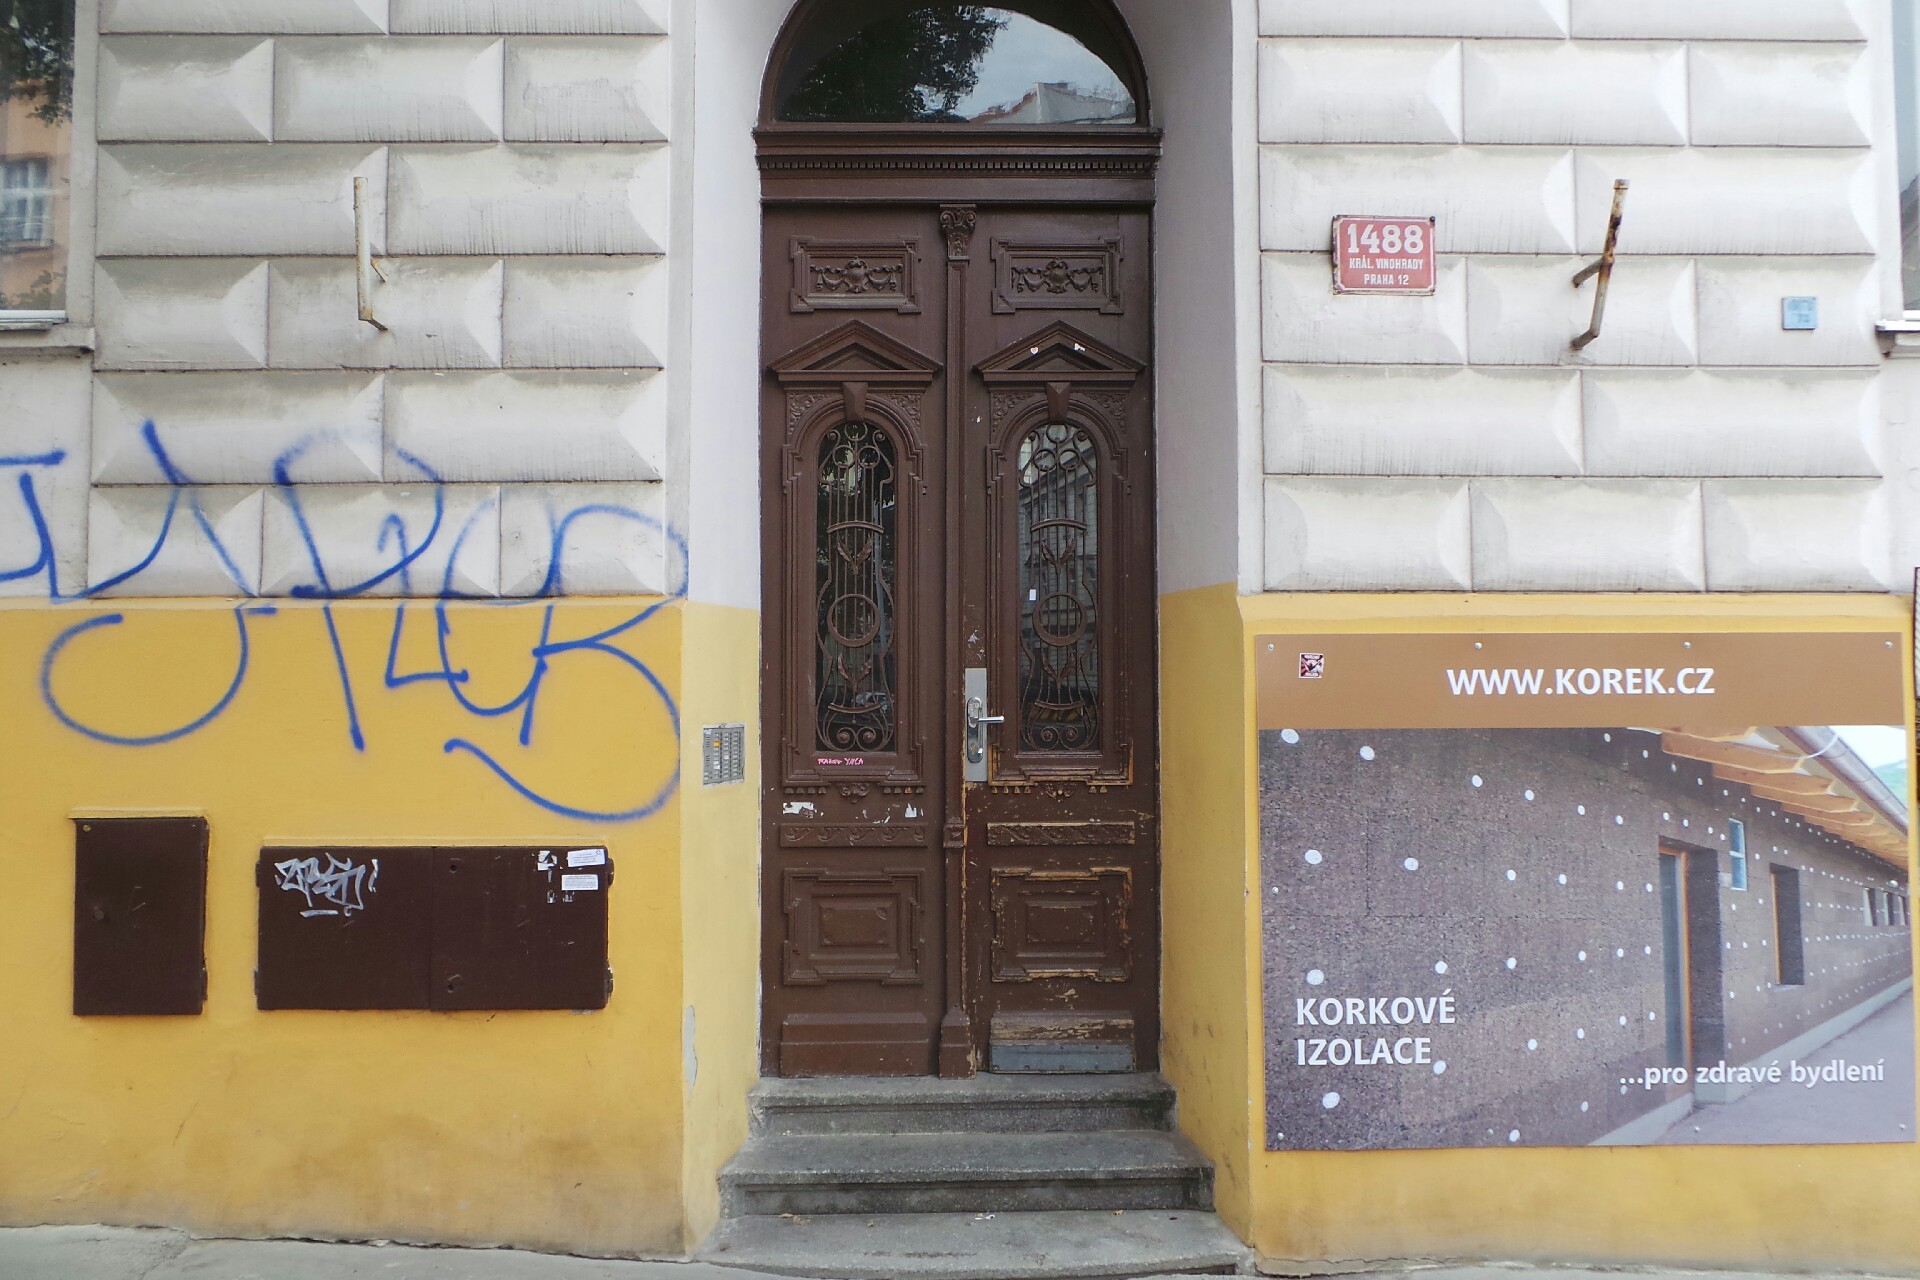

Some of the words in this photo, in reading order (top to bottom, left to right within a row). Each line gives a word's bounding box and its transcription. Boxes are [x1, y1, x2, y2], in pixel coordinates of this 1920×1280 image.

[1347, 223, 1424, 254] 1488
[1349, 255, 1374, 269] KRÁL.
[1376, 258, 1424, 270] VINOHRADY
[1364, 273, 1394, 285] PRAHA
[1397, 274, 1409, 286] 12
[1446, 668, 1716, 695] WWW.KOREK.CZ
[1297, 988, 1456, 1026] KORKOVÉ
[1297, 1037, 1431, 1066] IZOLACE
[1696, 1060, 1783, 1084] zdravé
[1790, 1058, 1886, 1089] bydlení
